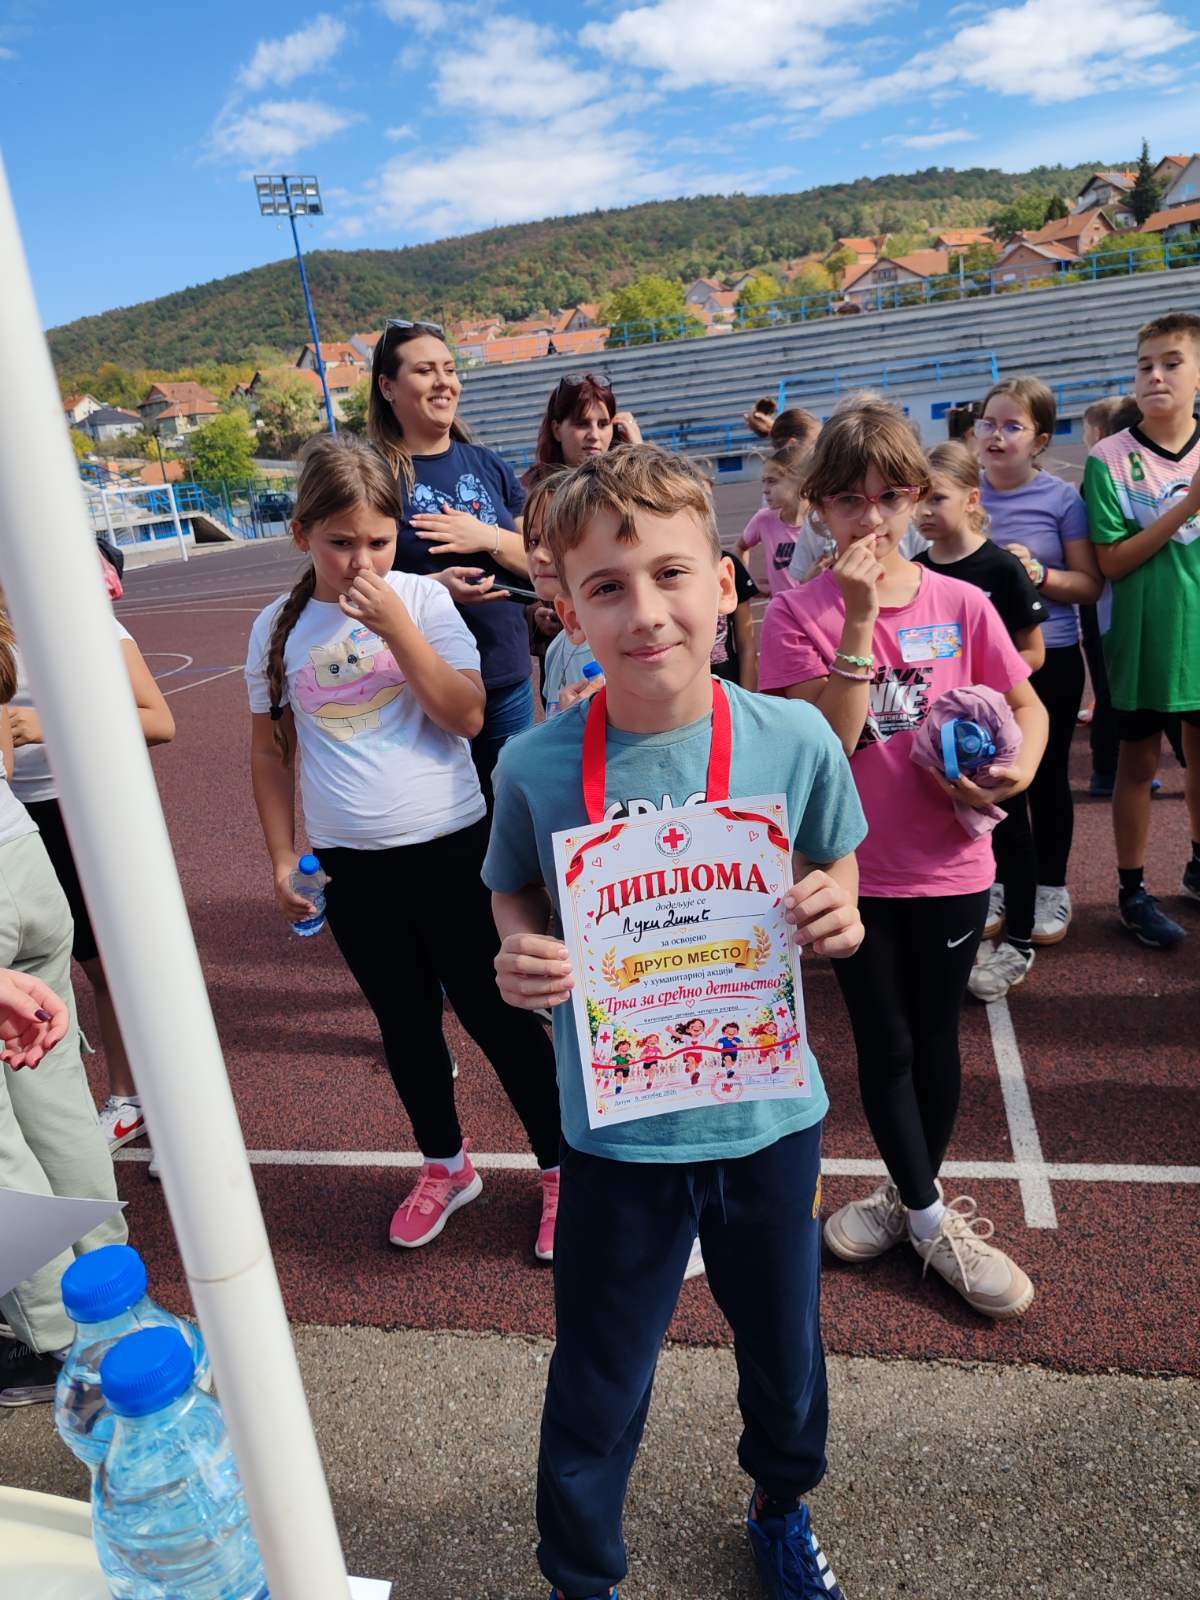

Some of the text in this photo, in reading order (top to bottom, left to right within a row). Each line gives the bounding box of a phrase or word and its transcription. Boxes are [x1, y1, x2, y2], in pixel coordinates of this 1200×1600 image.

[595, 863, 770, 925] ДИПЛОМА
[660, 933, 707, 948] за освојено
[633, 946, 741, 975] ДРУГО МЕСТО
[650, 968, 706, 988] хуманитарној
[707, 966, 733, 978] акцији
[640, 992, 655, 1006] за
[657, 985, 702, 1006] срећно
